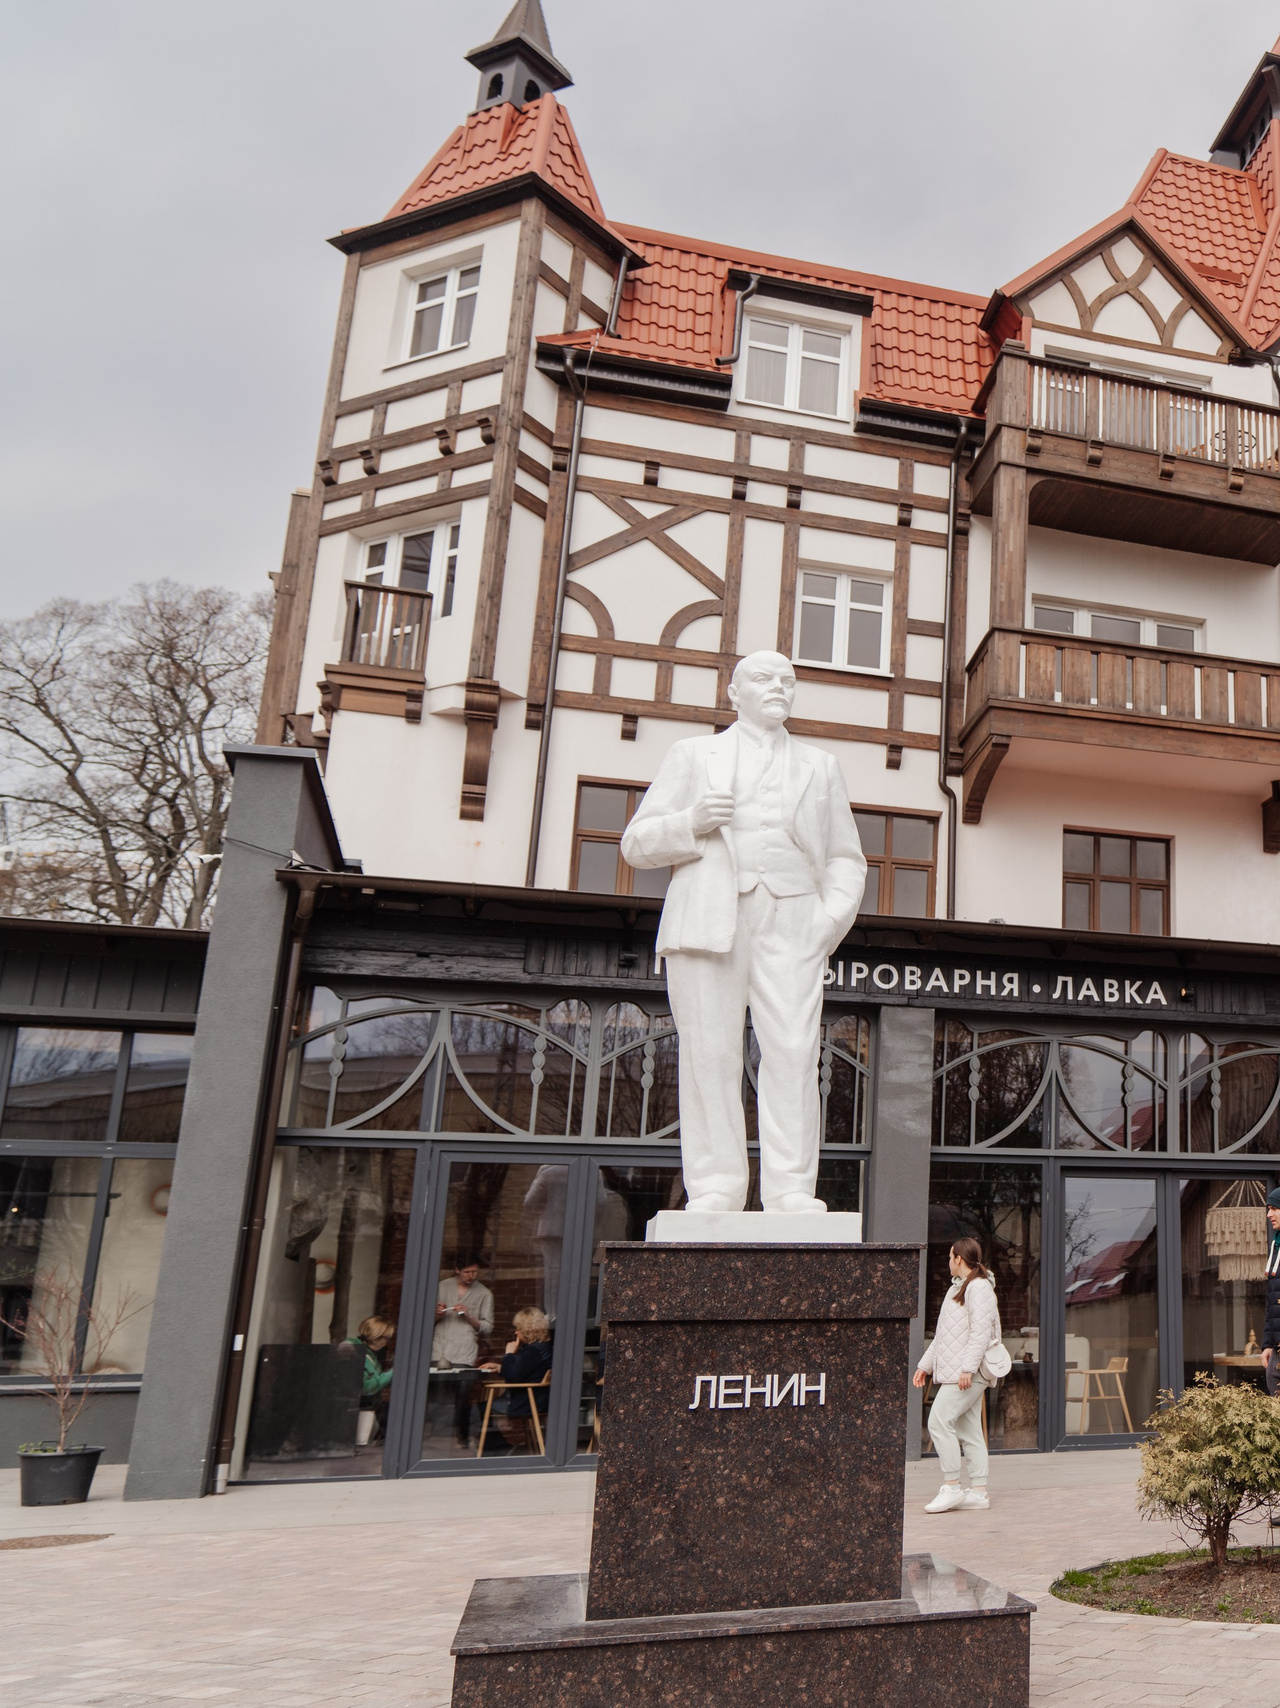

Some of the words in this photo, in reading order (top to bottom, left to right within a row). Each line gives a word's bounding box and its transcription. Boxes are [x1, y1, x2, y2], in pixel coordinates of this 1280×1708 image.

[823, 956, 1019, 997] ЫРОВАРНЯ
[1052, 976, 1168, 1005] ЛАВКА
[688, 1372, 826, 1410] ЛЕНИН
